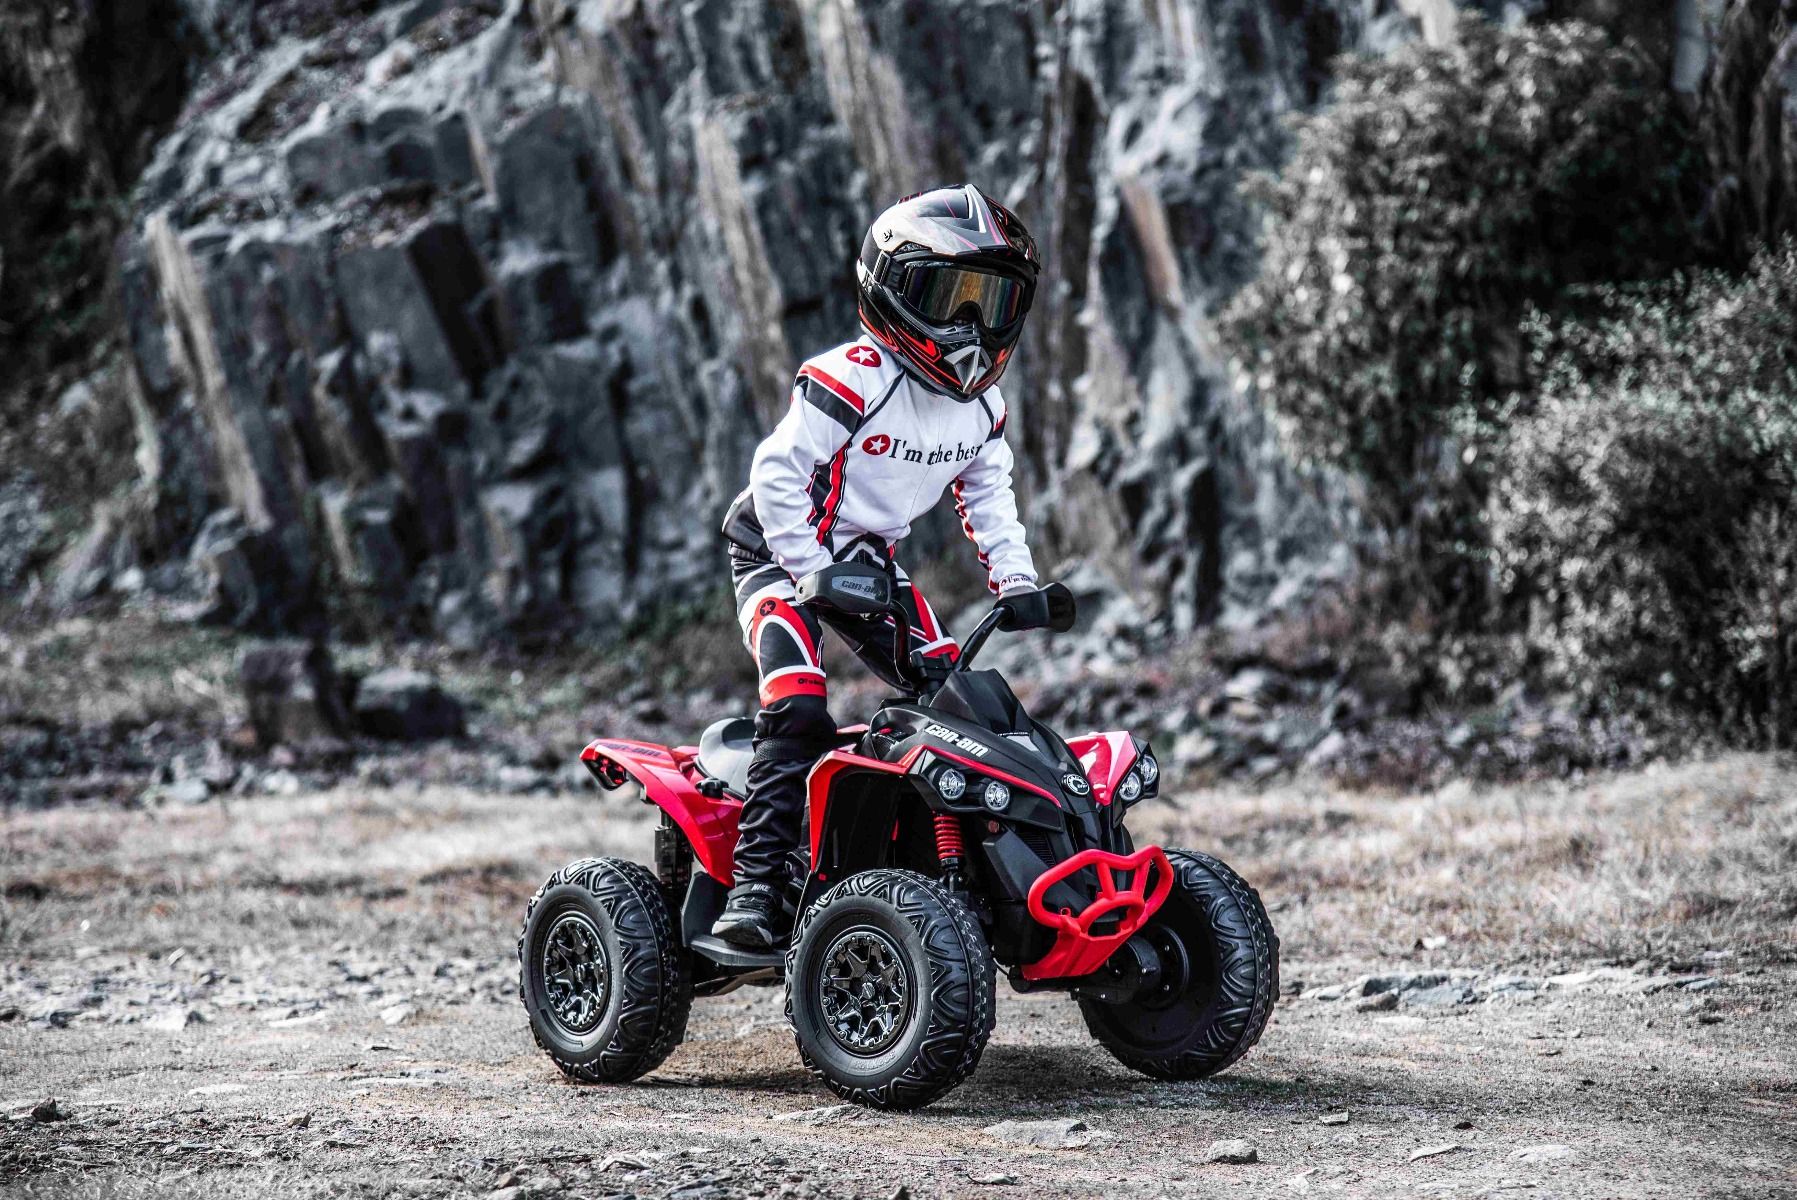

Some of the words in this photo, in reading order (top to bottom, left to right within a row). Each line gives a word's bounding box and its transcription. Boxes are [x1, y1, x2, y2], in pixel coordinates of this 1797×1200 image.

[889, 438, 923, 463] I'm
[927, 443, 953, 466] the
[924, 724, 989, 758] can-am
